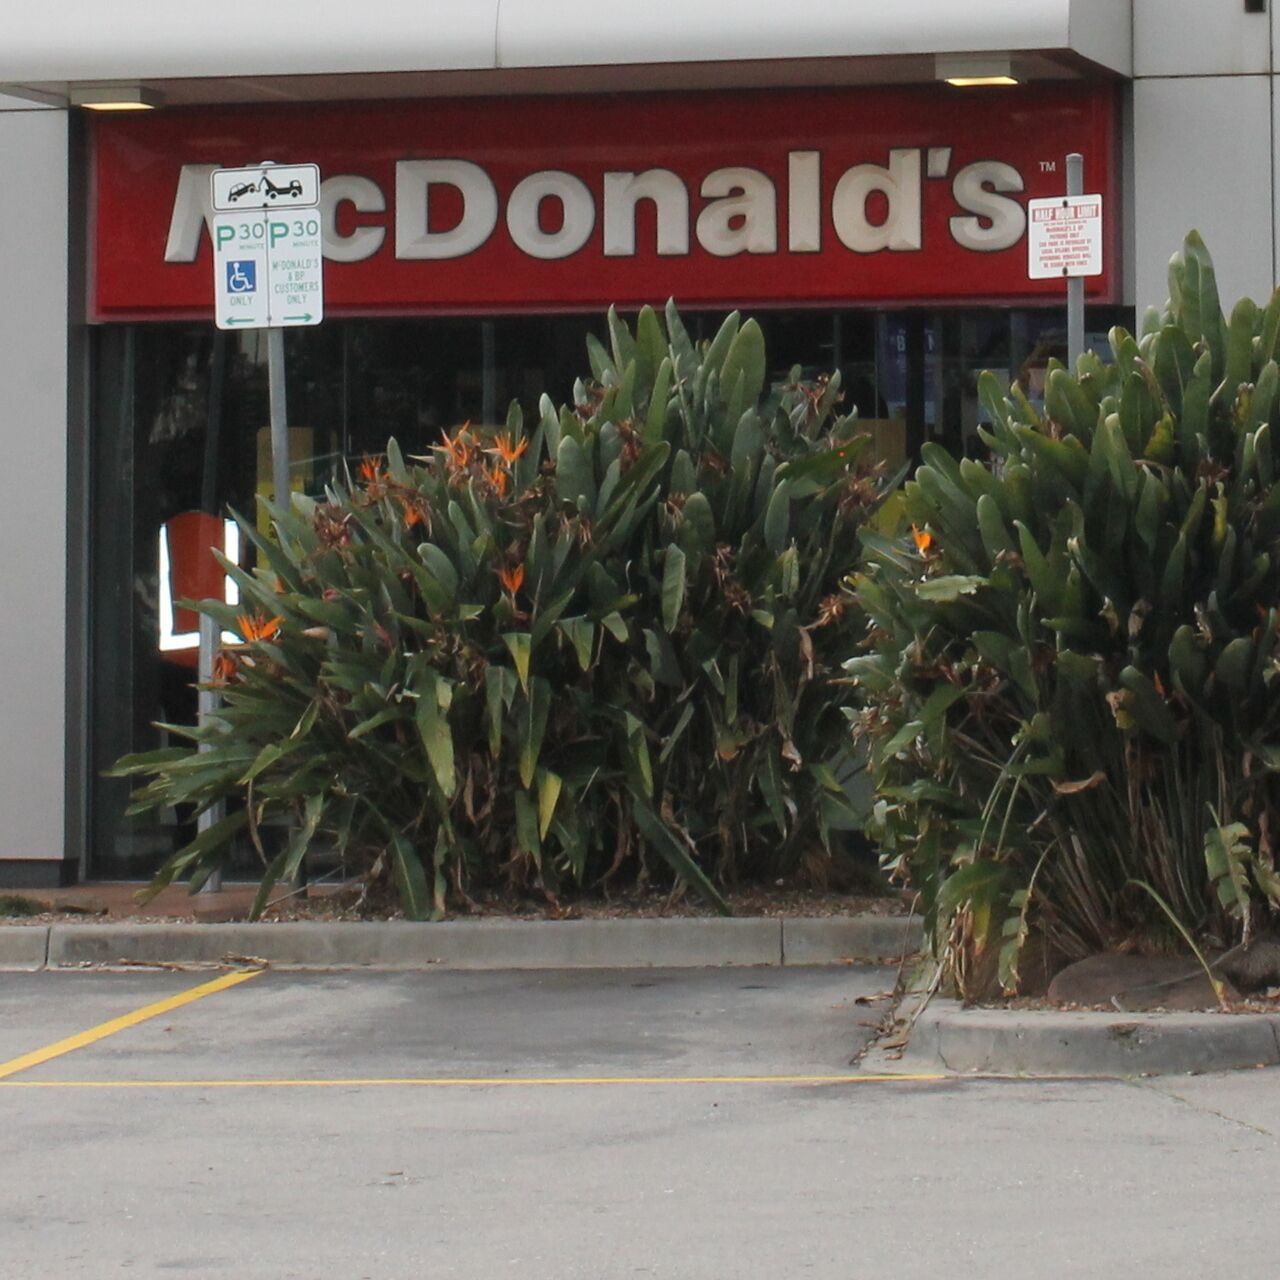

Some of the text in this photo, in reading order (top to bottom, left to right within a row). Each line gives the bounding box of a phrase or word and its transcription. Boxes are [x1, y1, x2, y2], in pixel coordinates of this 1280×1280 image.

[216, 223, 264, 251] P 30
[270, 220, 318, 248] P 30
